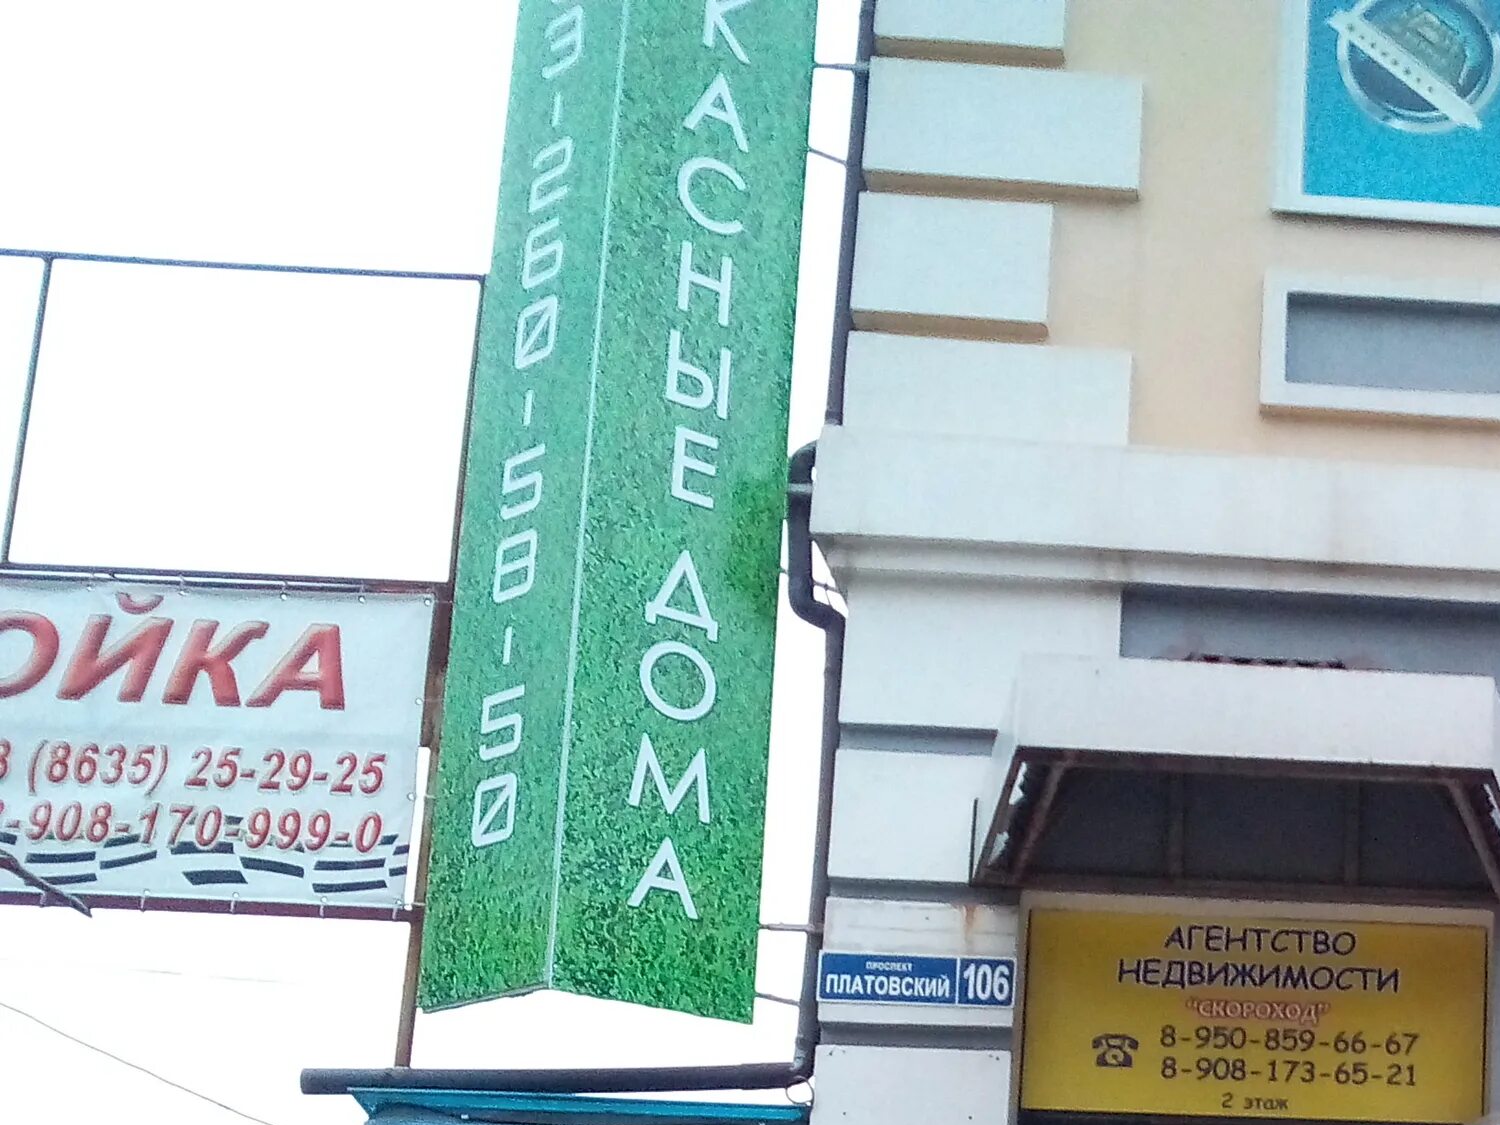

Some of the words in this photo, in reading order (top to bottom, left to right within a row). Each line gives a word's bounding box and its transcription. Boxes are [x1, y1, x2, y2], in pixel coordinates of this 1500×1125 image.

[627, 549, 719, 920] ДОМА
[27, 740, 168, 796] (8635)
[184, 745, 387, 794] 25-29-25
[0, 799, 384, 854] -908-170-999-0
[1164, 924, 1357, 956] АГЕНТСТВО
[825, 973, 950, 998] ПЛАТОВСКИЙ
[963, 962, 1010, 1001] 106
[865, 961, 913, 972] ПРОСПЕКТ
[1118, 957, 1400, 993] НЕДВИЖИМОСТИ
[1160, 1024, 1420, 1055] 8-950-859-66-67
[1160, 1056, 1417, 1087] 8-908-173-65-21
[1221, 1092, 1233, 1109] 2
[1243, 1096, 1289, 1111] этаж
